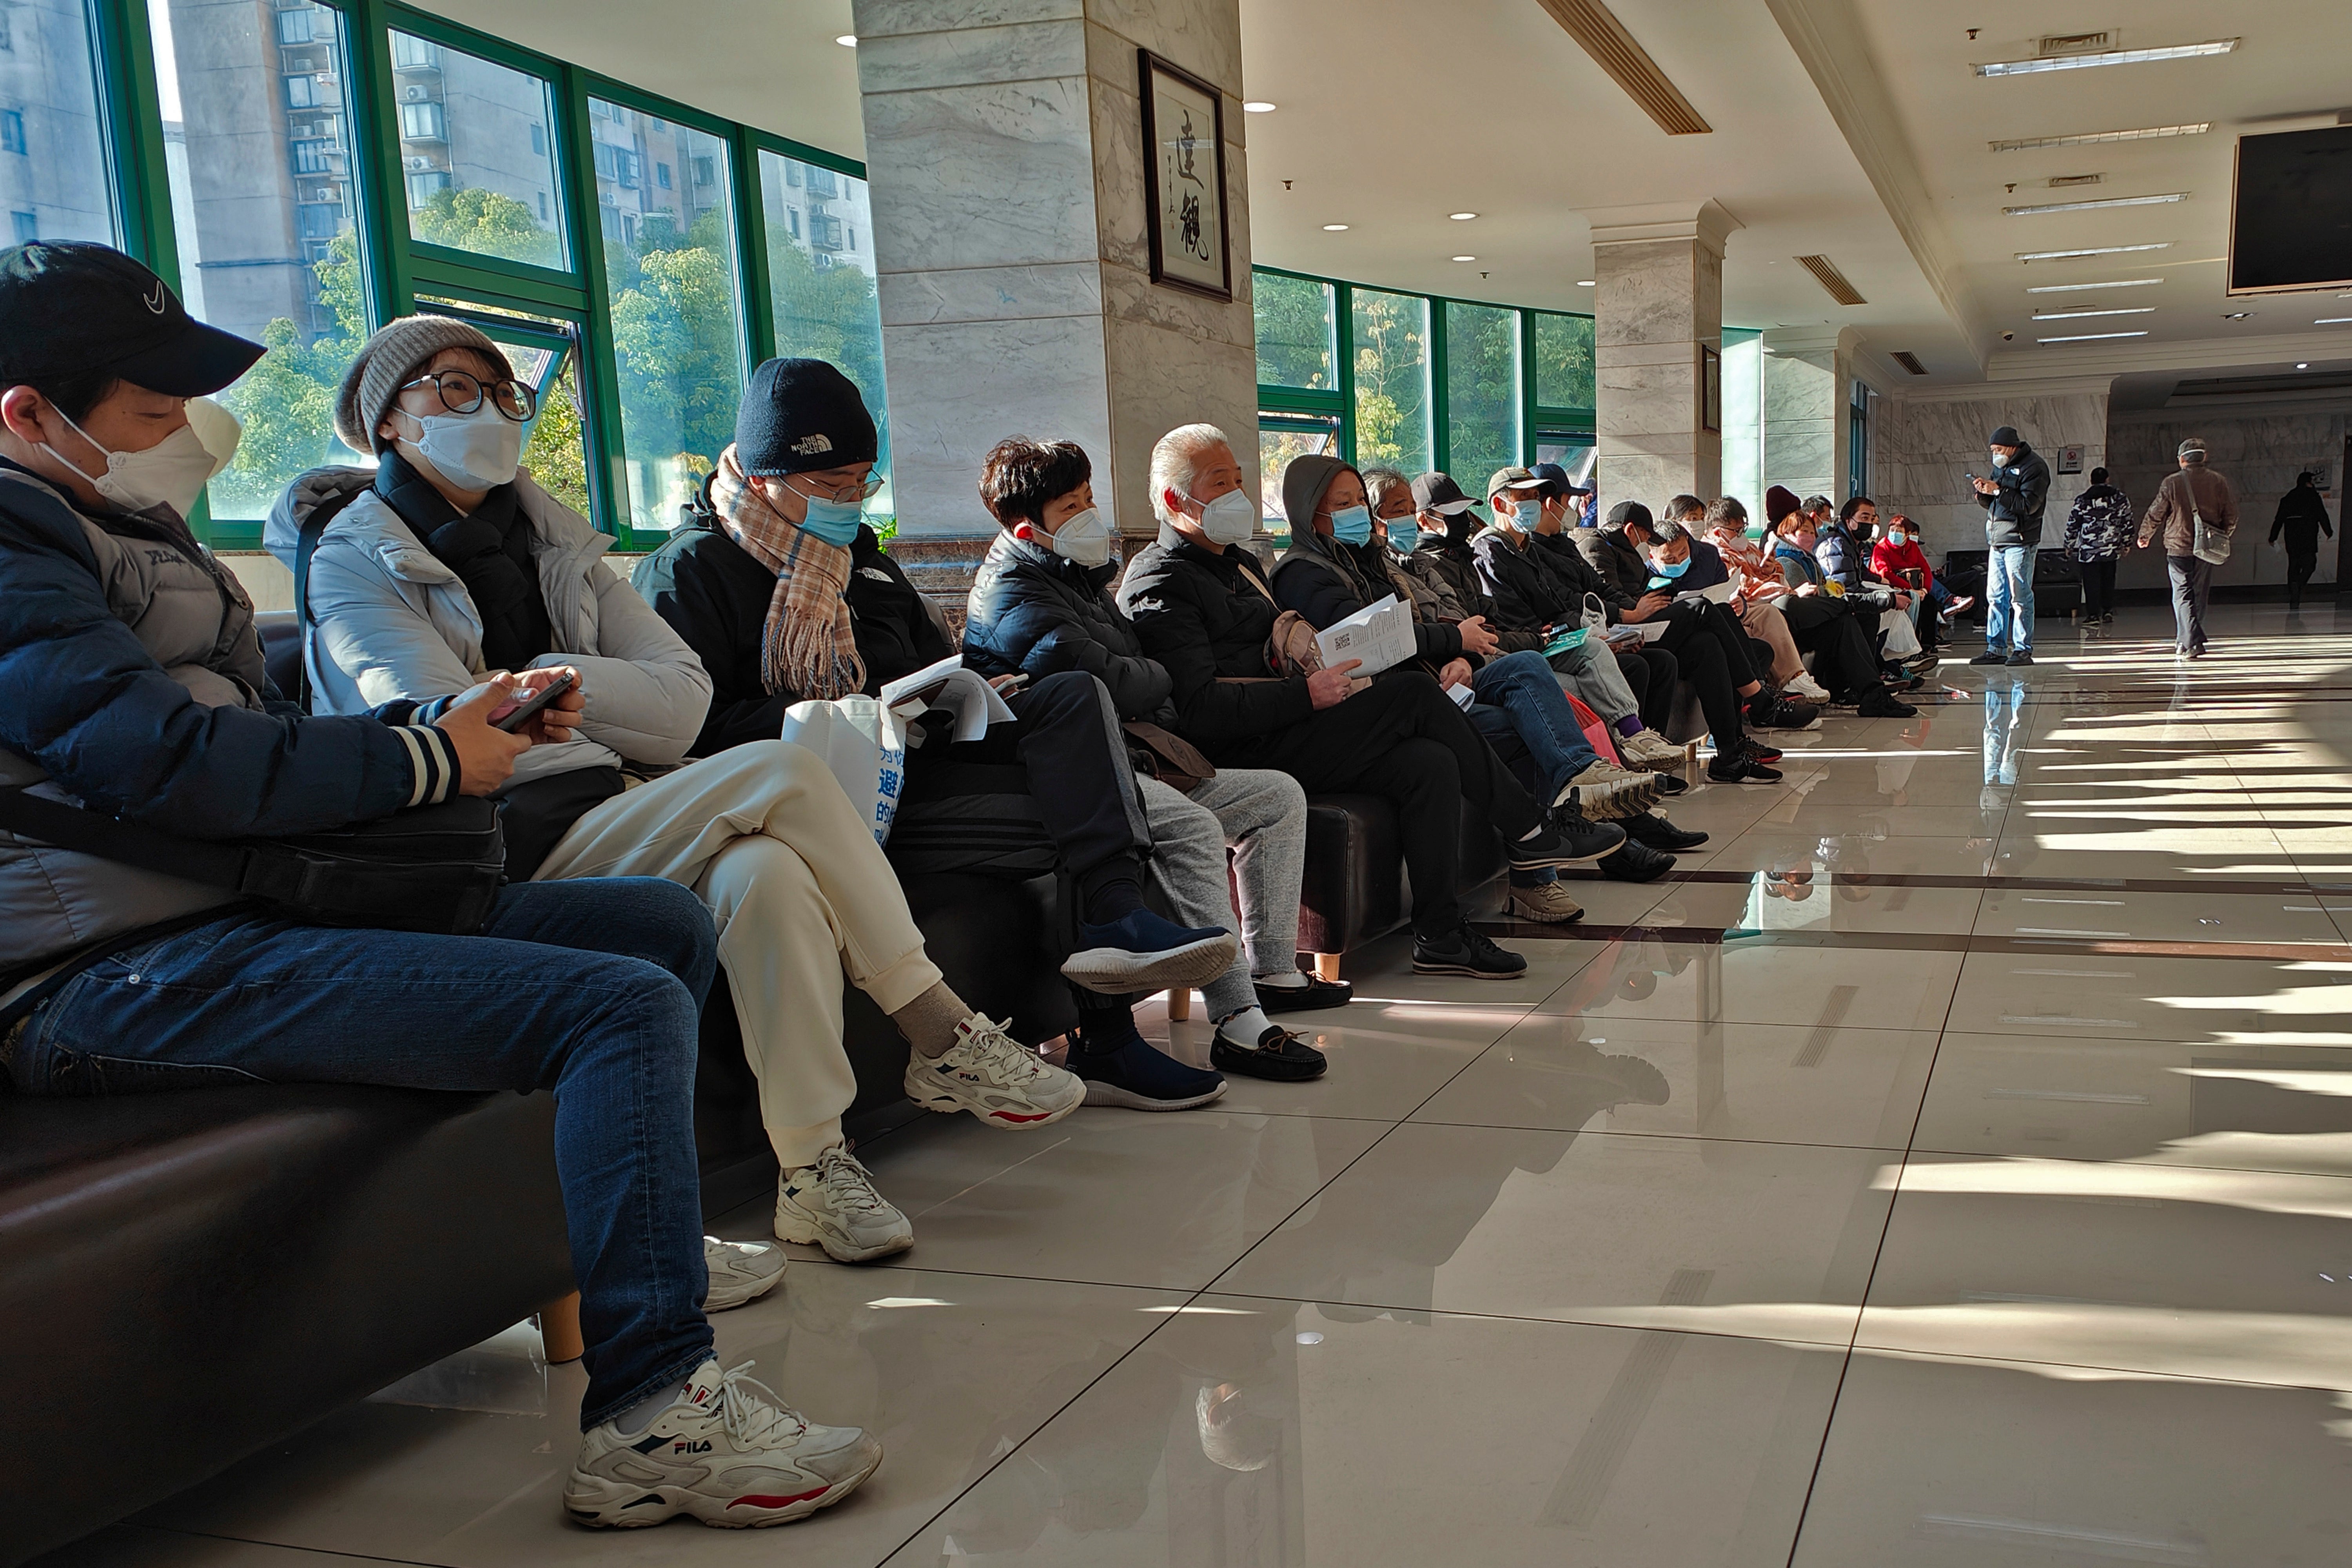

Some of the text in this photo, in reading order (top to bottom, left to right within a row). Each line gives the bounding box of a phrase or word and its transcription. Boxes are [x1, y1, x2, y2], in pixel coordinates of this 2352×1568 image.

[800, 435, 816, 443] THE
[791, 441, 818, 452] NORTH
[800, 447, 819, 456] FACE
[878, 768, 904, 800] 避
[959, 1073, 980, 1082] FILA
[674, 1440, 712, 1455] FILA
